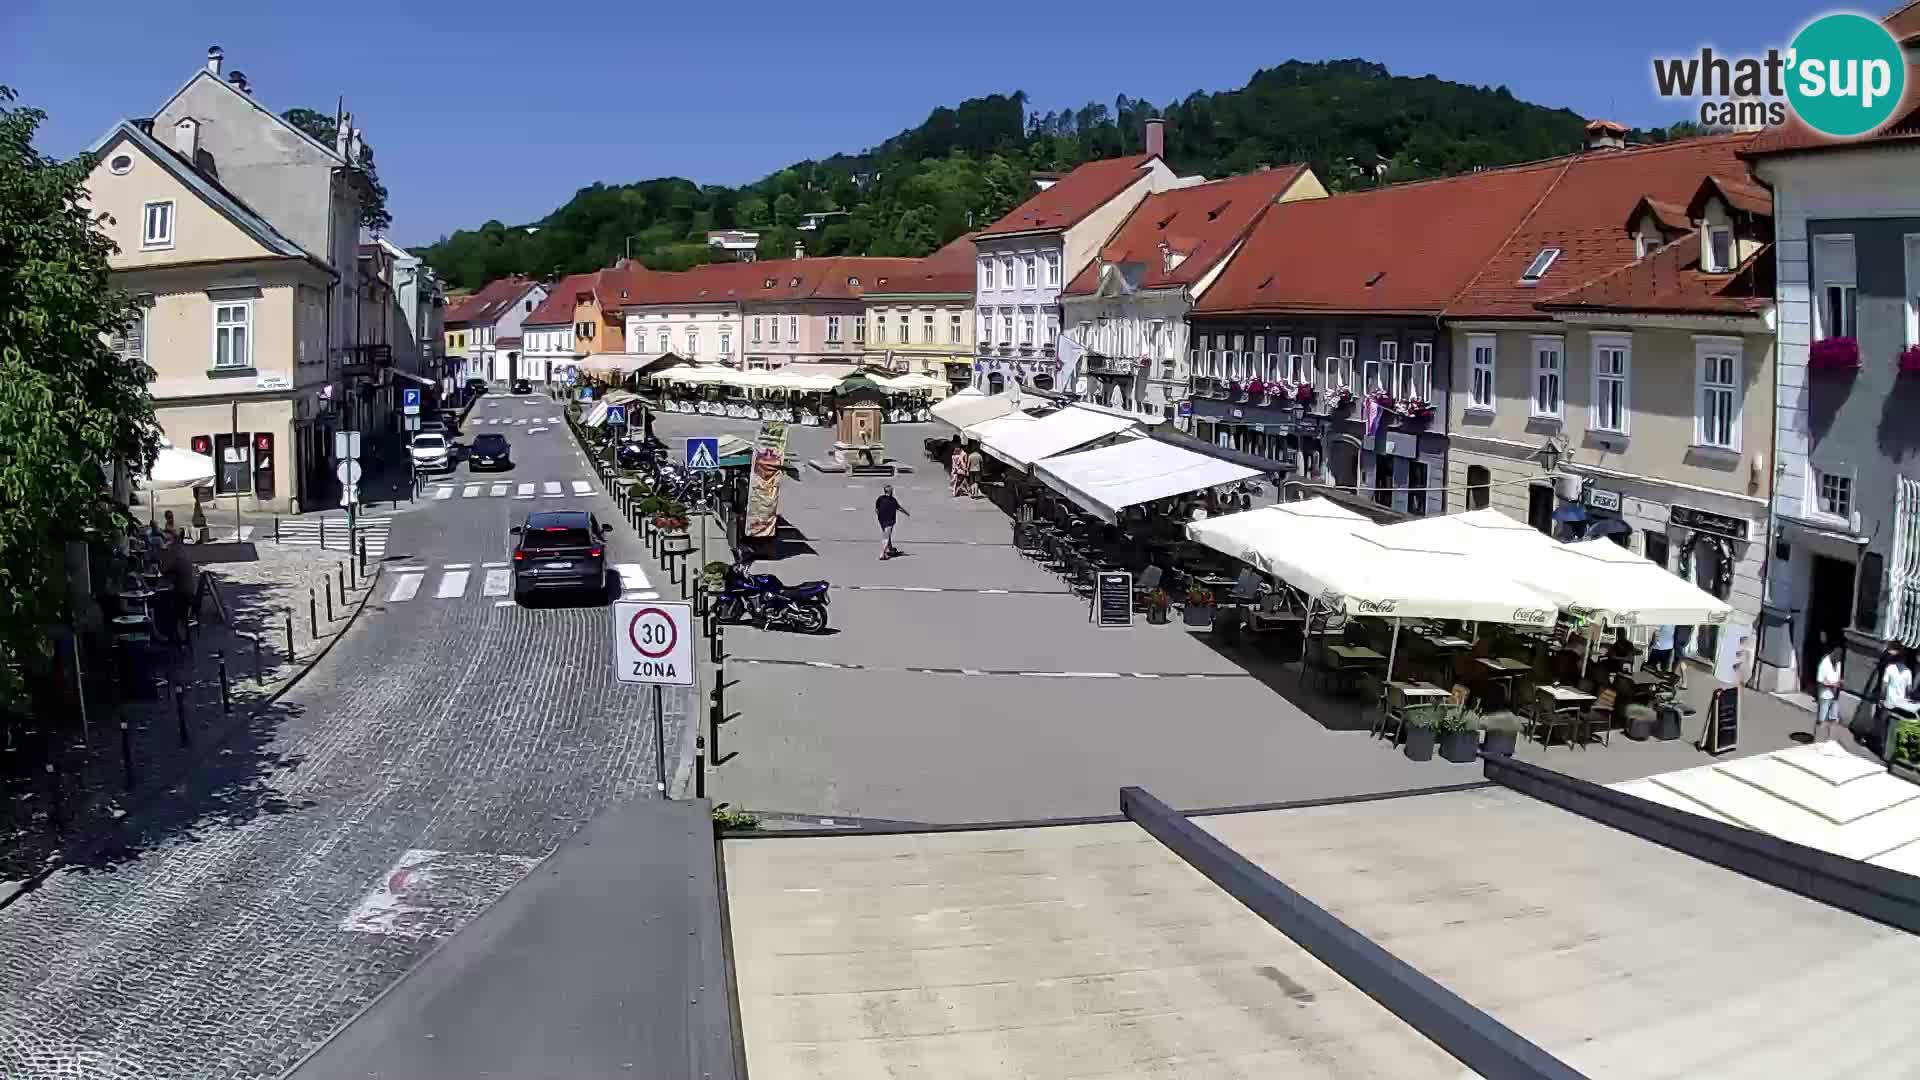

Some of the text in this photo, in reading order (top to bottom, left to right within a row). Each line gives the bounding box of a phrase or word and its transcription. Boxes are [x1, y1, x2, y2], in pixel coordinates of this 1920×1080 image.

[407, 392, 416, 404] P
[641, 623, 666, 645] 30
[632, 660, 677, 678] ZONA
